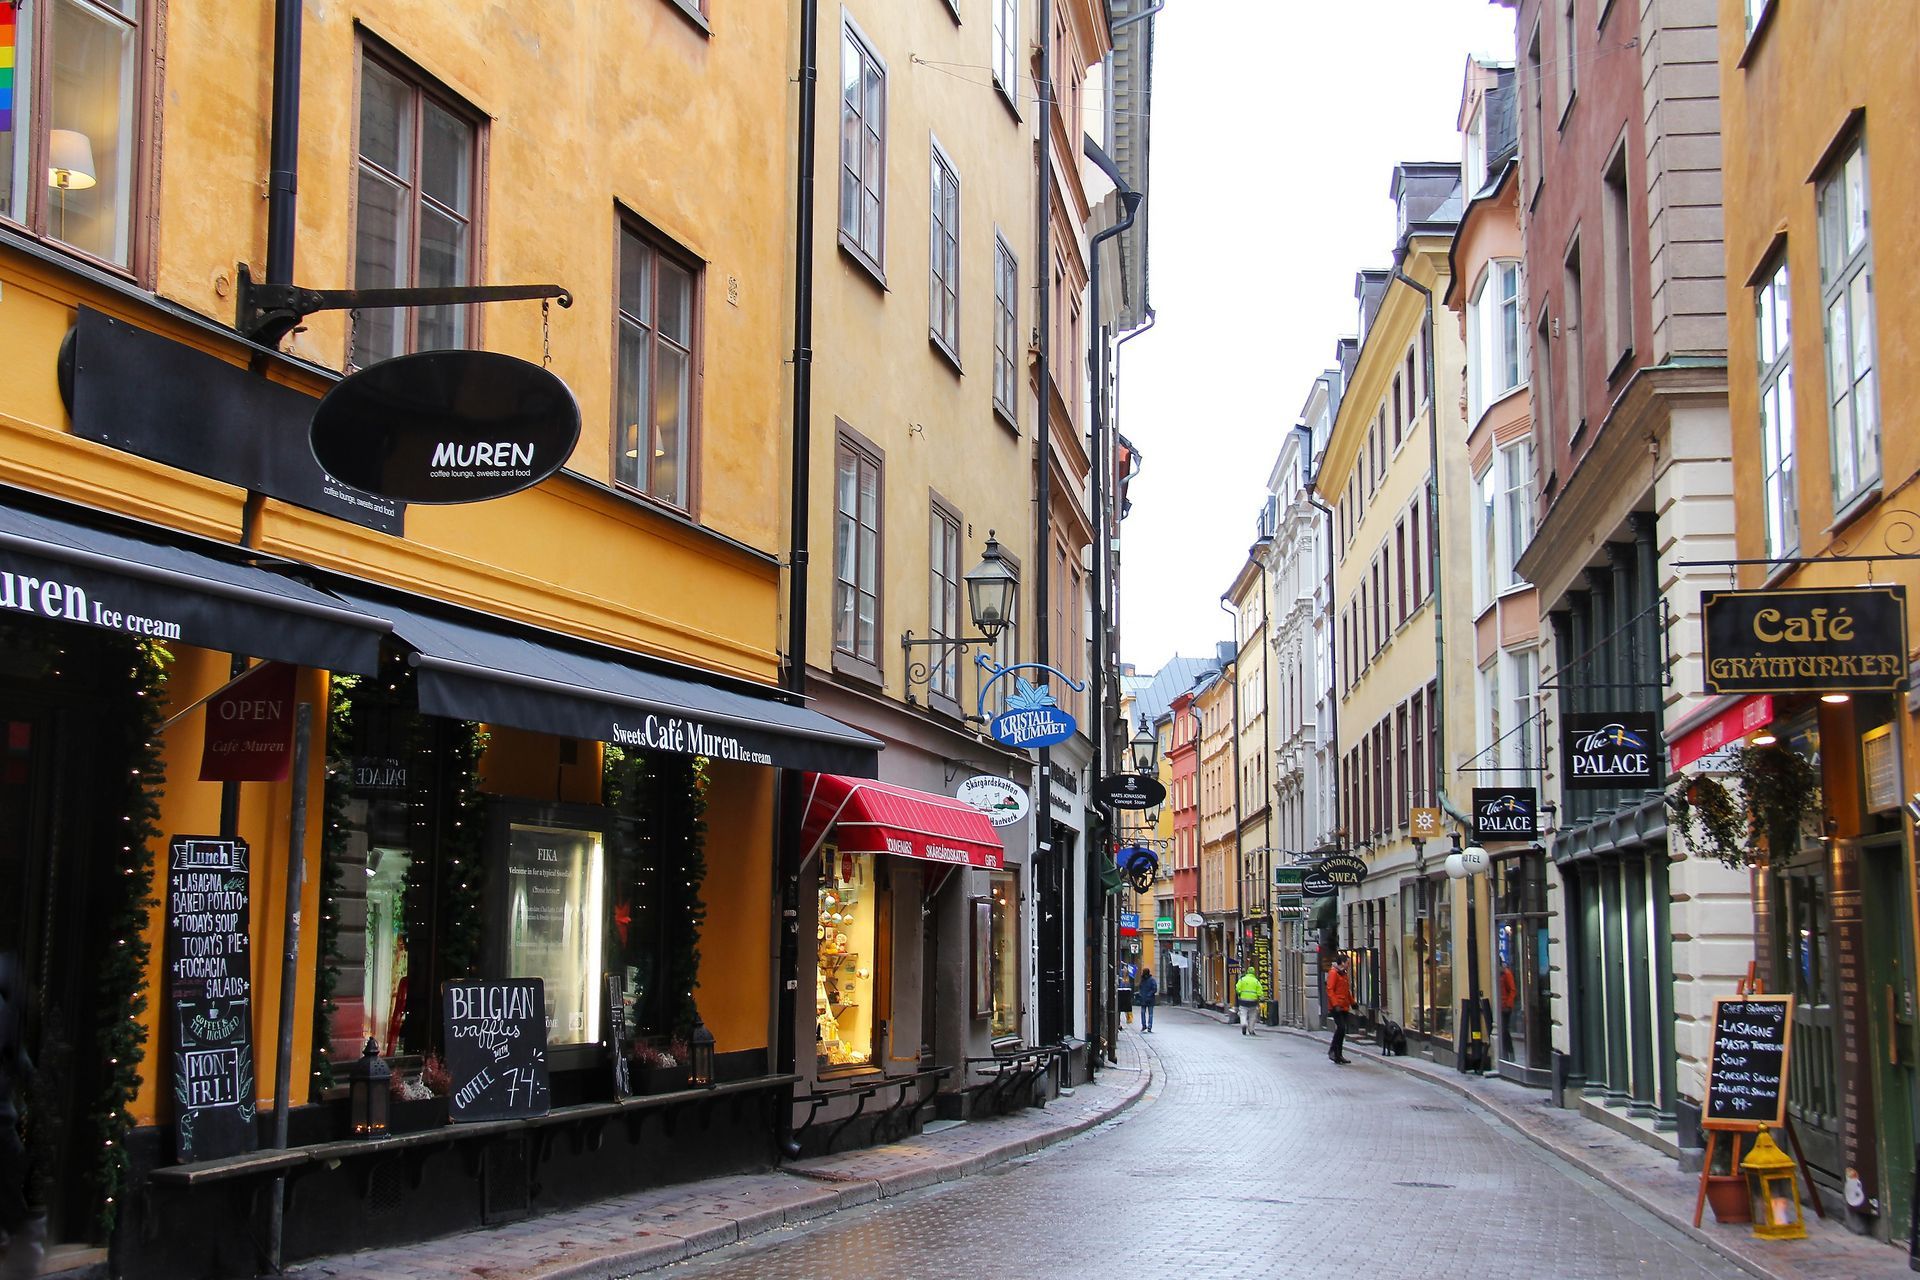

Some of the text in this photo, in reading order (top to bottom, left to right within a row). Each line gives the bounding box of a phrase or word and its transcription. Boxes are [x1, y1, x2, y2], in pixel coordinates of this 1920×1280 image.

[431, 442, 534, 467] MUREN
[476, 470, 500, 478] sweets
[515, 469, 531, 477] food
[93, 600, 122, 629] Ice
[126, 613, 181, 640] cream
[1753, 607, 1855, 643] Café
[1710, 652, 1901, 679] GRÅMUNKEN
[220, 700, 283, 721] OPEN
[1000, 710, 1055, 739] KRISTALL
[1013, 723, 1067, 745] RUMMET
[241, 740, 285, 752] Muren
[613, 714, 772, 765] Sweets Café Muren Ice cream
[1576, 731, 1611, 752] The
[1573, 753, 1649, 774] PALACE
[1479, 816, 1531, 830] PALACE
[188, 843, 229, 865] Lunch
[537, 848, 558, 862] FIKA
[180, 873, 222, 892] LASAGNA
[1328, 872, 1359, 883] SWEA
[173, 891, 243, 914] BAKED POTATO
[215, 912, 239, 933] SOUP
[227, 932, 243, 954] PIE
[206, 976, 244, 999] SALADS
[449, 986, 535, 1020] BELGIAN
[206, 1015, 240, 1041] INCLUDED
[452, 1018, 520, 1049] waffles
[455, 1066, 495, 1109] COFFEE
